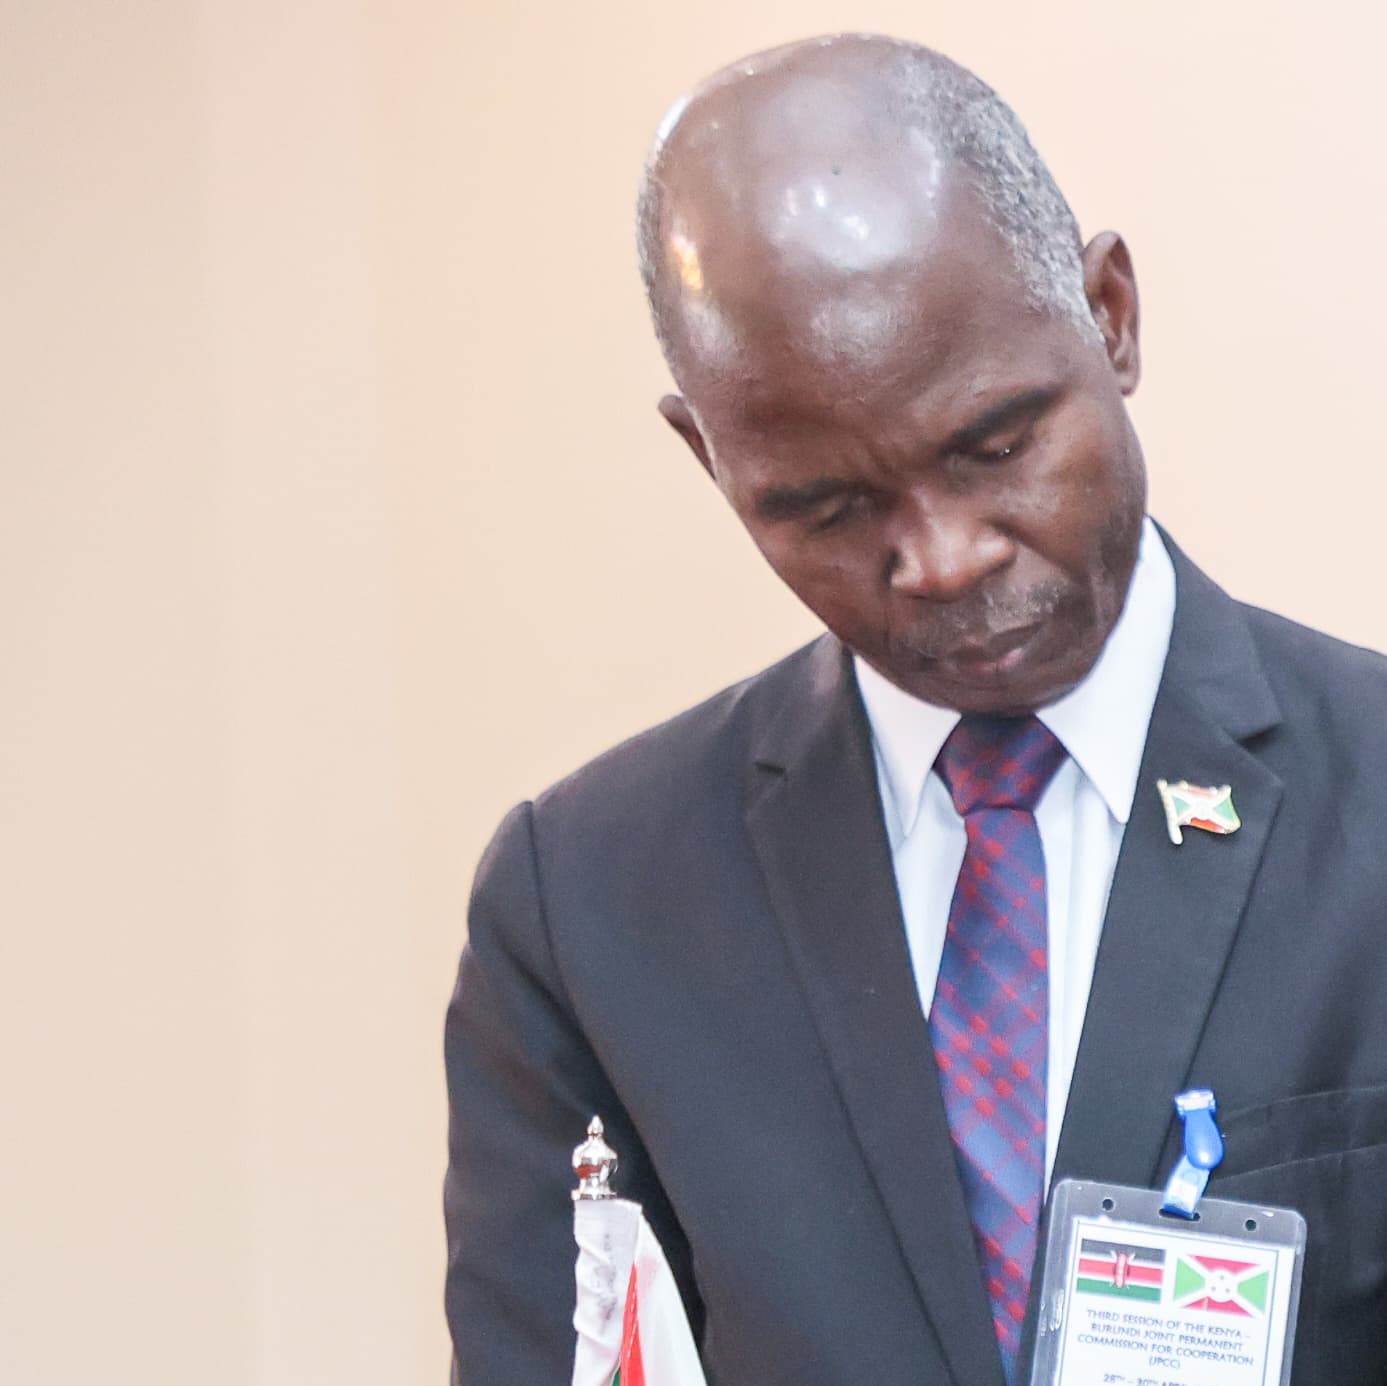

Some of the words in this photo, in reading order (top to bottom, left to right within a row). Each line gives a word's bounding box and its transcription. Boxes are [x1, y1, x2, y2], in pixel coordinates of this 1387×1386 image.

[1087, 1309, 1120, 1322] THIRD
[1122, 1313, 1164, 1327] SESSION
[1166, 1320, 1181, 1329] OF
[1184, 1322, 1205, 1333] THE
[1208, 1326, 1242, 1338] KENYA
[1091, 1323, 1141, 1338] BURUNDI
[1144, 1330, 1175, 1342] JOINT
[1178, 1335, 1243, 1351] PERMANENT
[1077, 1334, 1148, 1351] COMMISSION
[1151, 1344, 1173, 1354] FOR
[1176, 1347, 1254, 1366] COOPERATION
